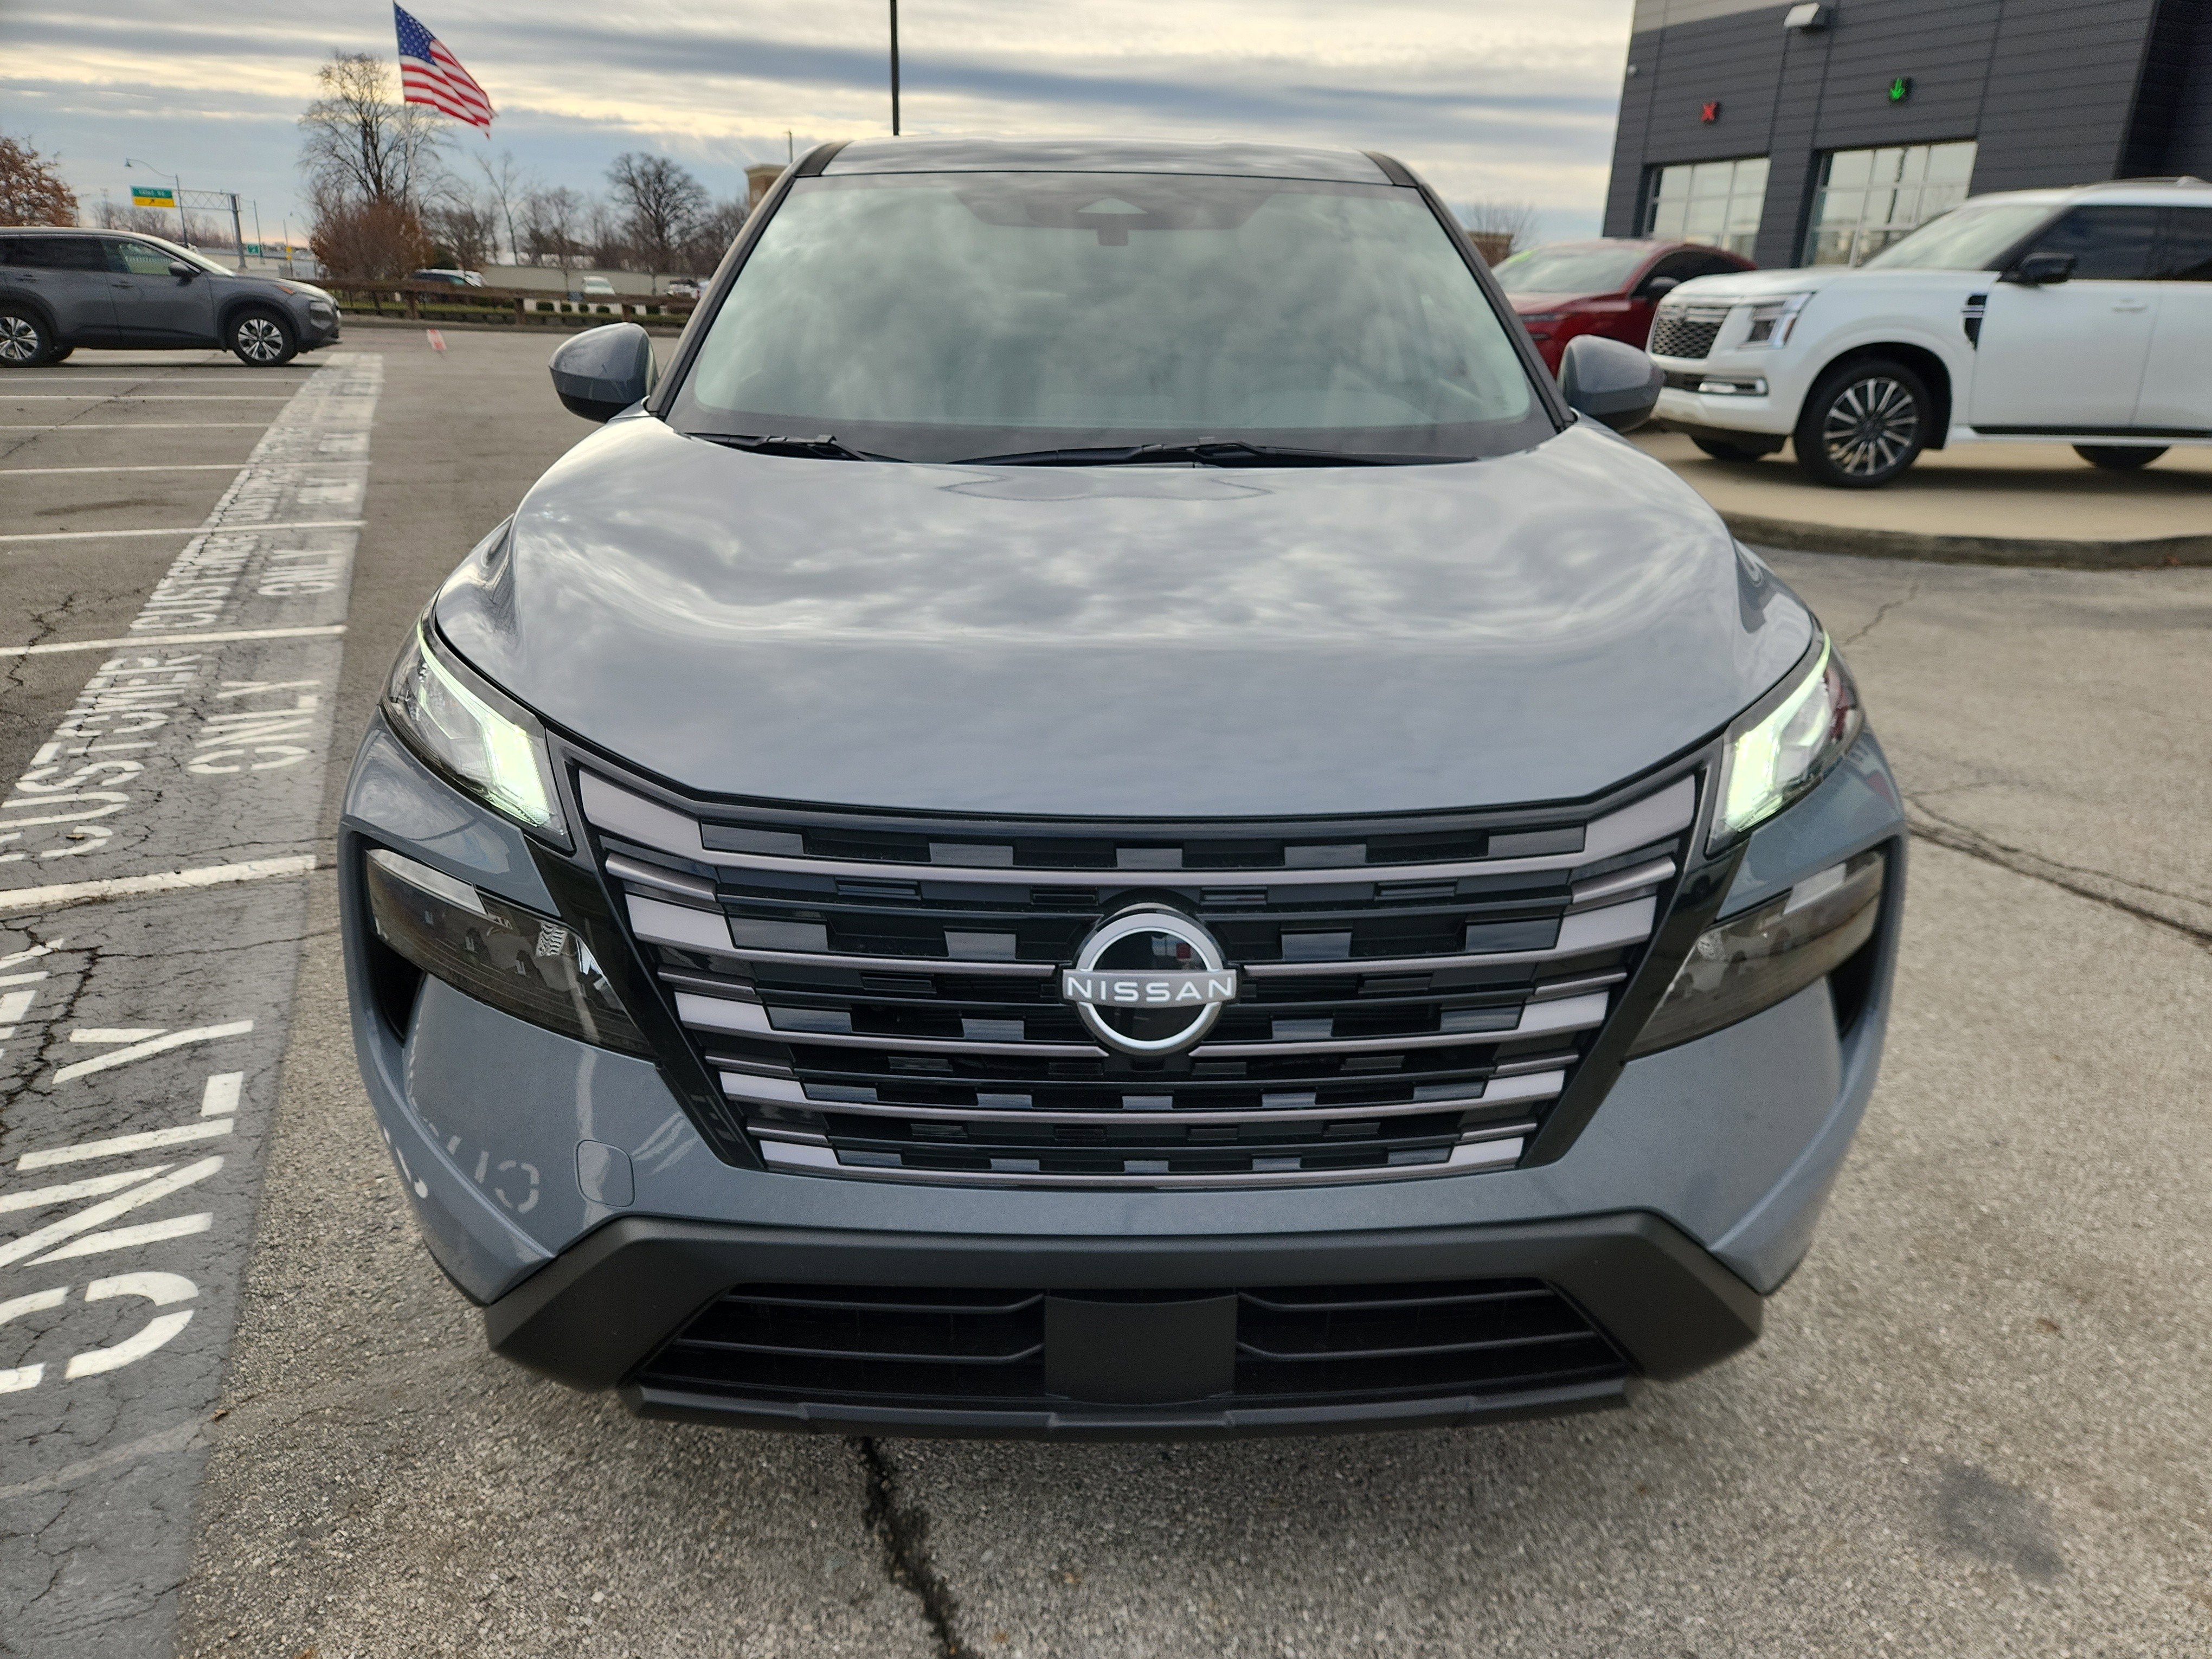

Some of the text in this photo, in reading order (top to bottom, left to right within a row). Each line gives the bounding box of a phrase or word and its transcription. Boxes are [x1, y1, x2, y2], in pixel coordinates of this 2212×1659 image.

[258, 549, 348, 596] ONLY
[0, 654, 202, 863] CUSTOMER
[188, 680, 321, 774] ONLY
[1066, 976, 1232, 1003] NISSAN
[0, 1019, 254, 1396] ONLY
